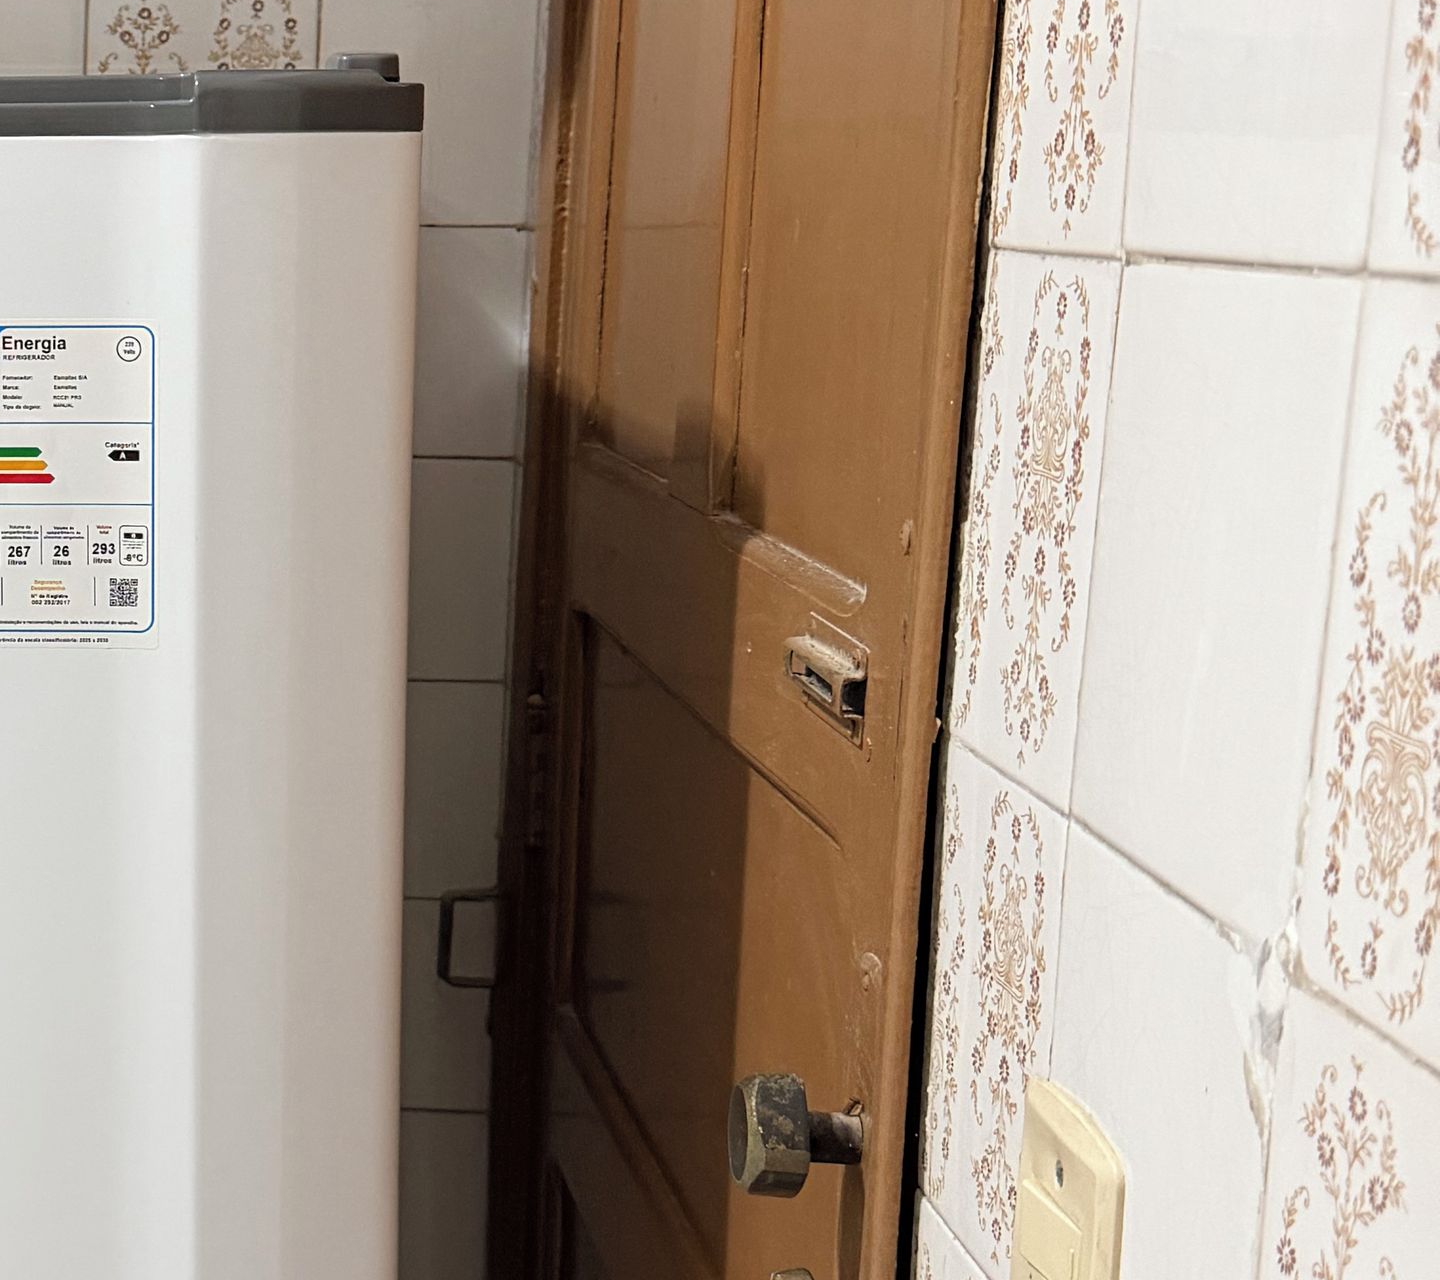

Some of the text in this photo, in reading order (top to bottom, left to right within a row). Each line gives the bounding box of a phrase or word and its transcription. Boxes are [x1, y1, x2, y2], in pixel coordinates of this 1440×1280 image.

[2, 336, 67, 354] Energia
[119, 451, 127, 460] A
[7, 545, 31, 558] 267
[53, 545, 70, 557] 26
[92, 542, 116, 555] 293
